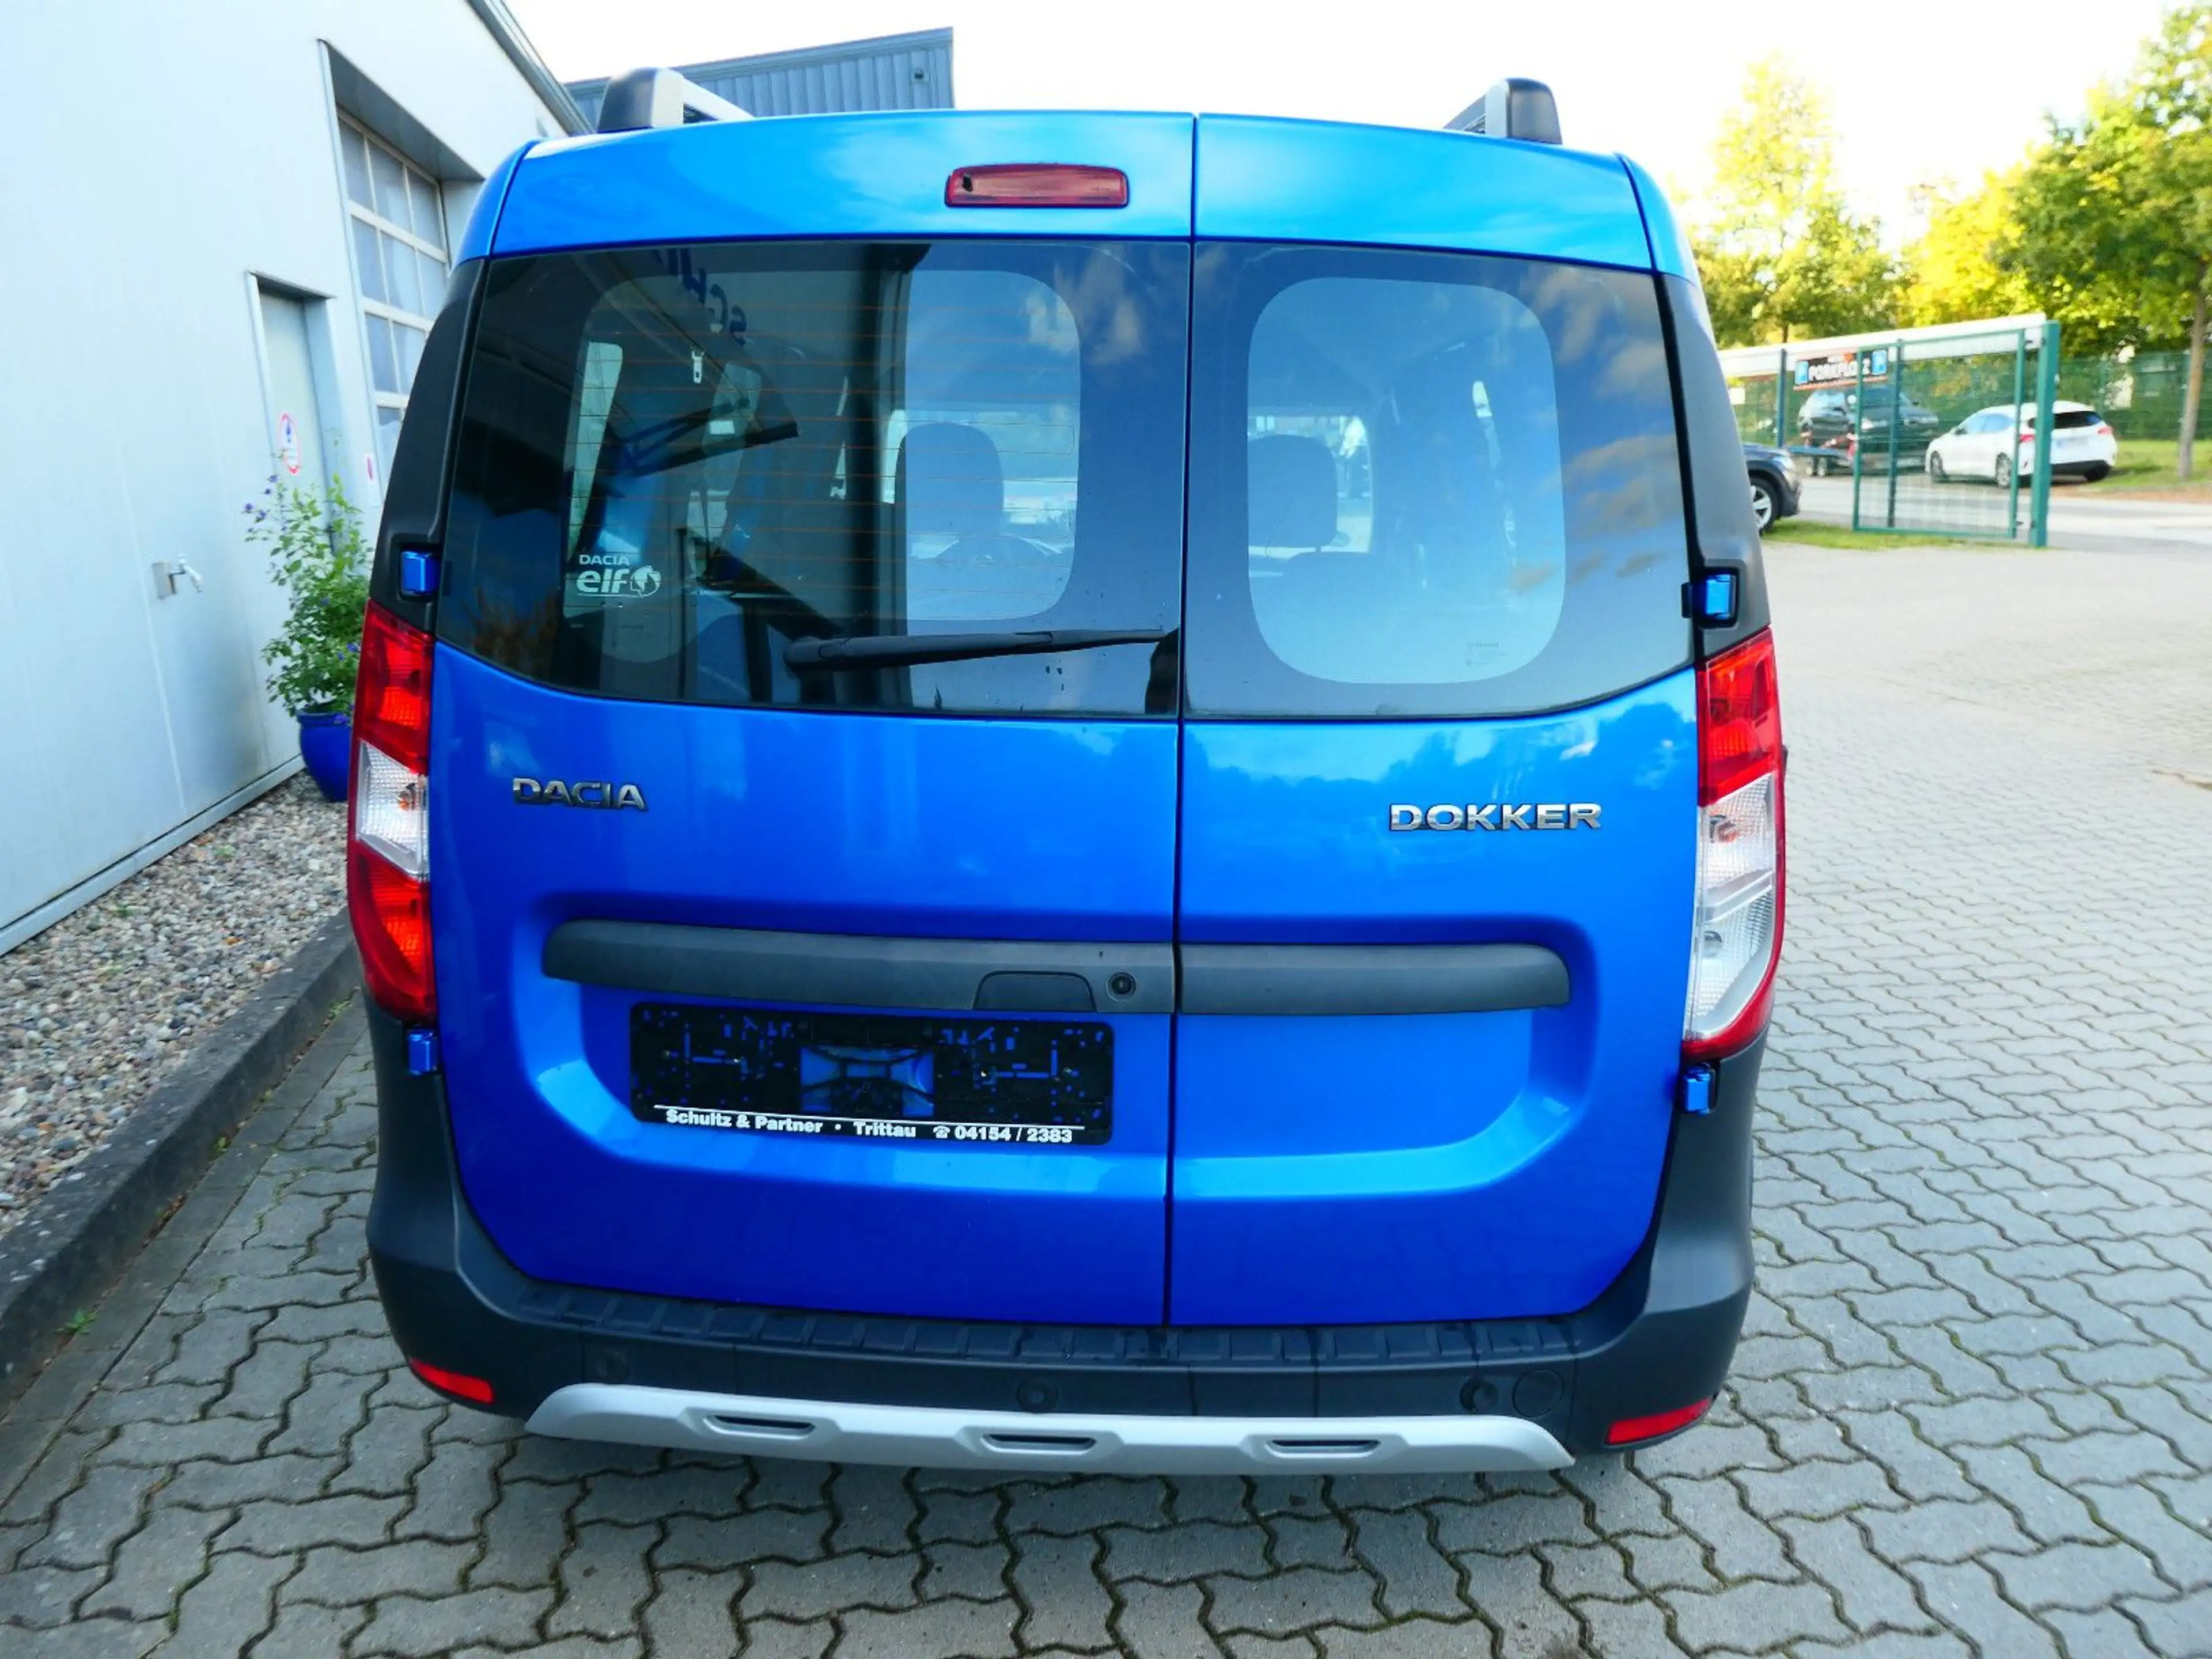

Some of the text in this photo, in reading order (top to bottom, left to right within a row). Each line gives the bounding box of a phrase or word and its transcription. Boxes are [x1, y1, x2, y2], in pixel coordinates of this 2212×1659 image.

[579, 554, 630, 566] DACIA
[577, 568, 630, 593] elf
[513, 777, 647, 811] DACIA
[1389, 804, 1602, 831] DOKKER
[666, 1109, 732, 1127] Schultz
[736, 1114, 751, 1129] &
[755, 1115, 823, 1133] Partner
[853, 1121, 916, 1138] Trittau
[954, 1125, 1012, 1141] 04154
[1027, 1128, 1073, 1143] 2383
